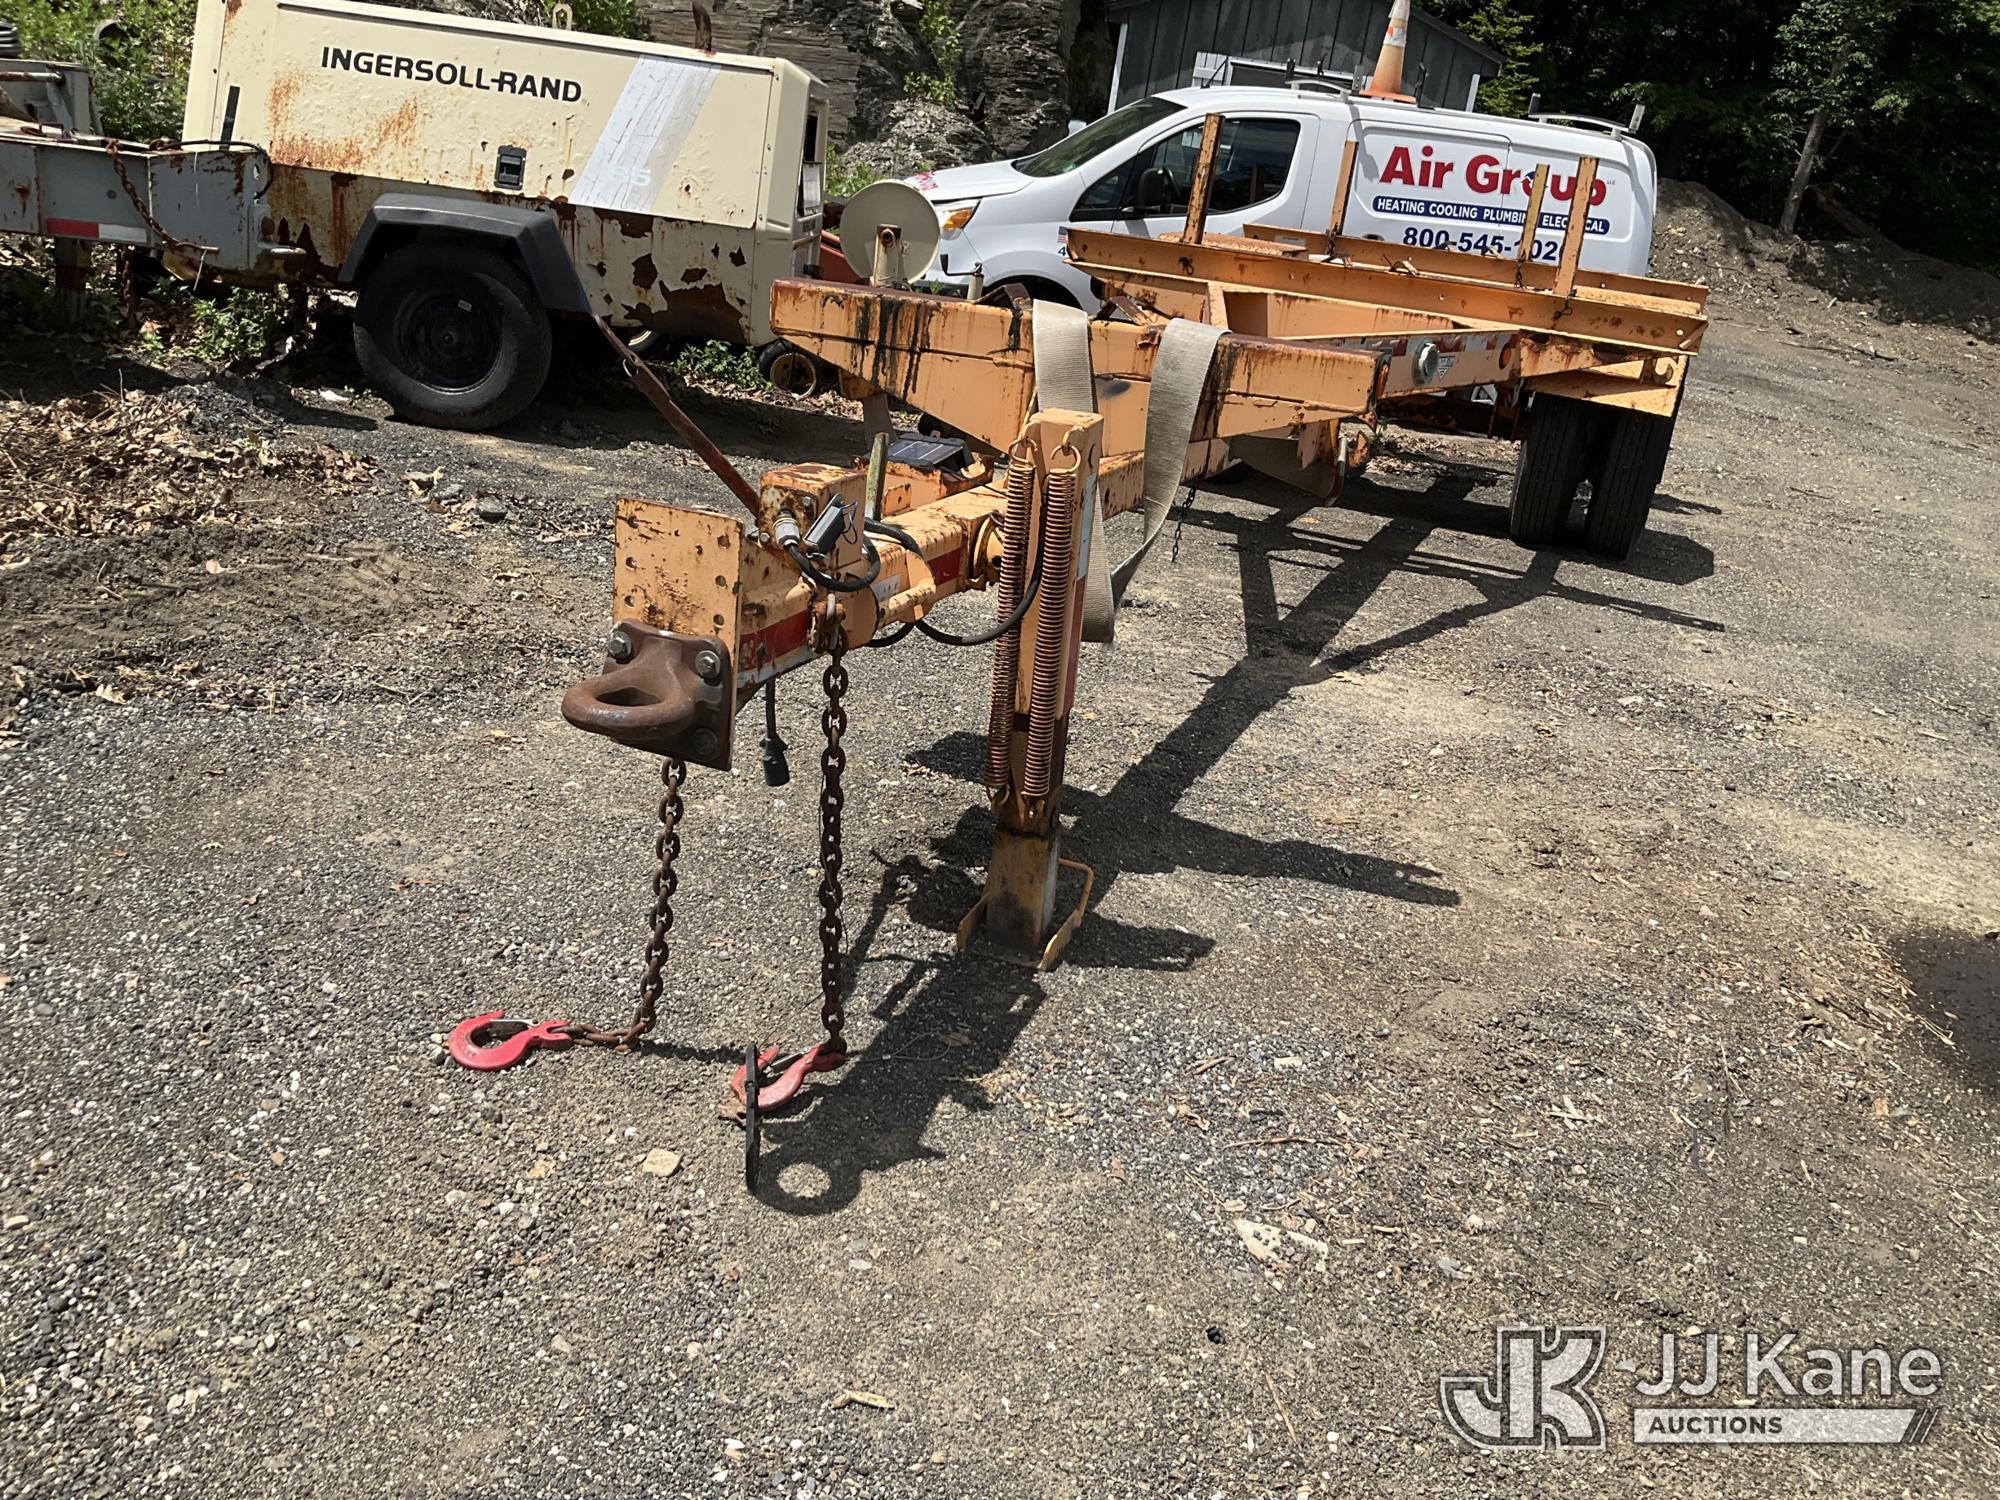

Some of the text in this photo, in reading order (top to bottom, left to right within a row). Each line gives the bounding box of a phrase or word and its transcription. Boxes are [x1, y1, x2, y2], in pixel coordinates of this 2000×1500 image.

[321, 46, 582, 103] INGERSOLL-RAND
[1379, 145, 1454, 189] Air
[1377, 198, 1605, 233] HEATING COOLING PLUMBIN ELECCAL
